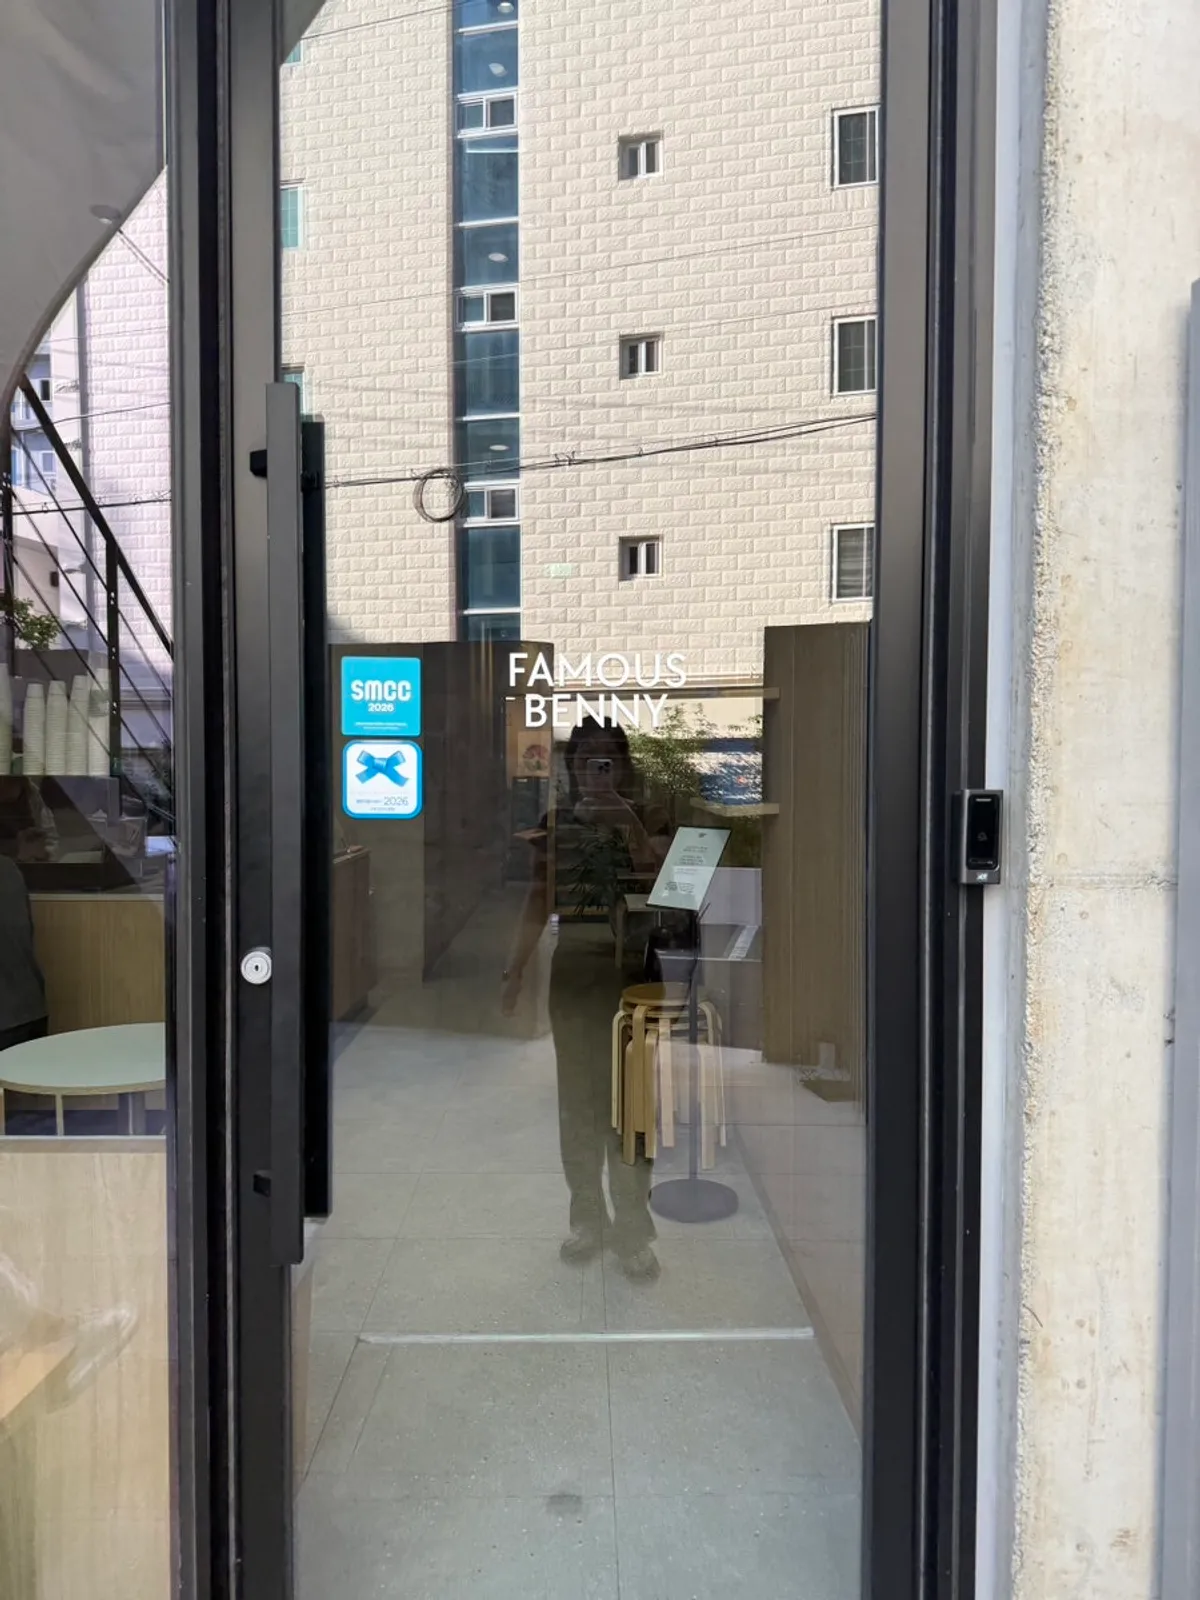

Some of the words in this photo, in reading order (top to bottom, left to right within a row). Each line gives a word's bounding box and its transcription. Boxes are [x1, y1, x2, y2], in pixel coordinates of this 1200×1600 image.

[508, 652, 687, 688] FAMOUS
[368, 702, 394, 712] 2026
[524, 693, 669, 728] BENNY
